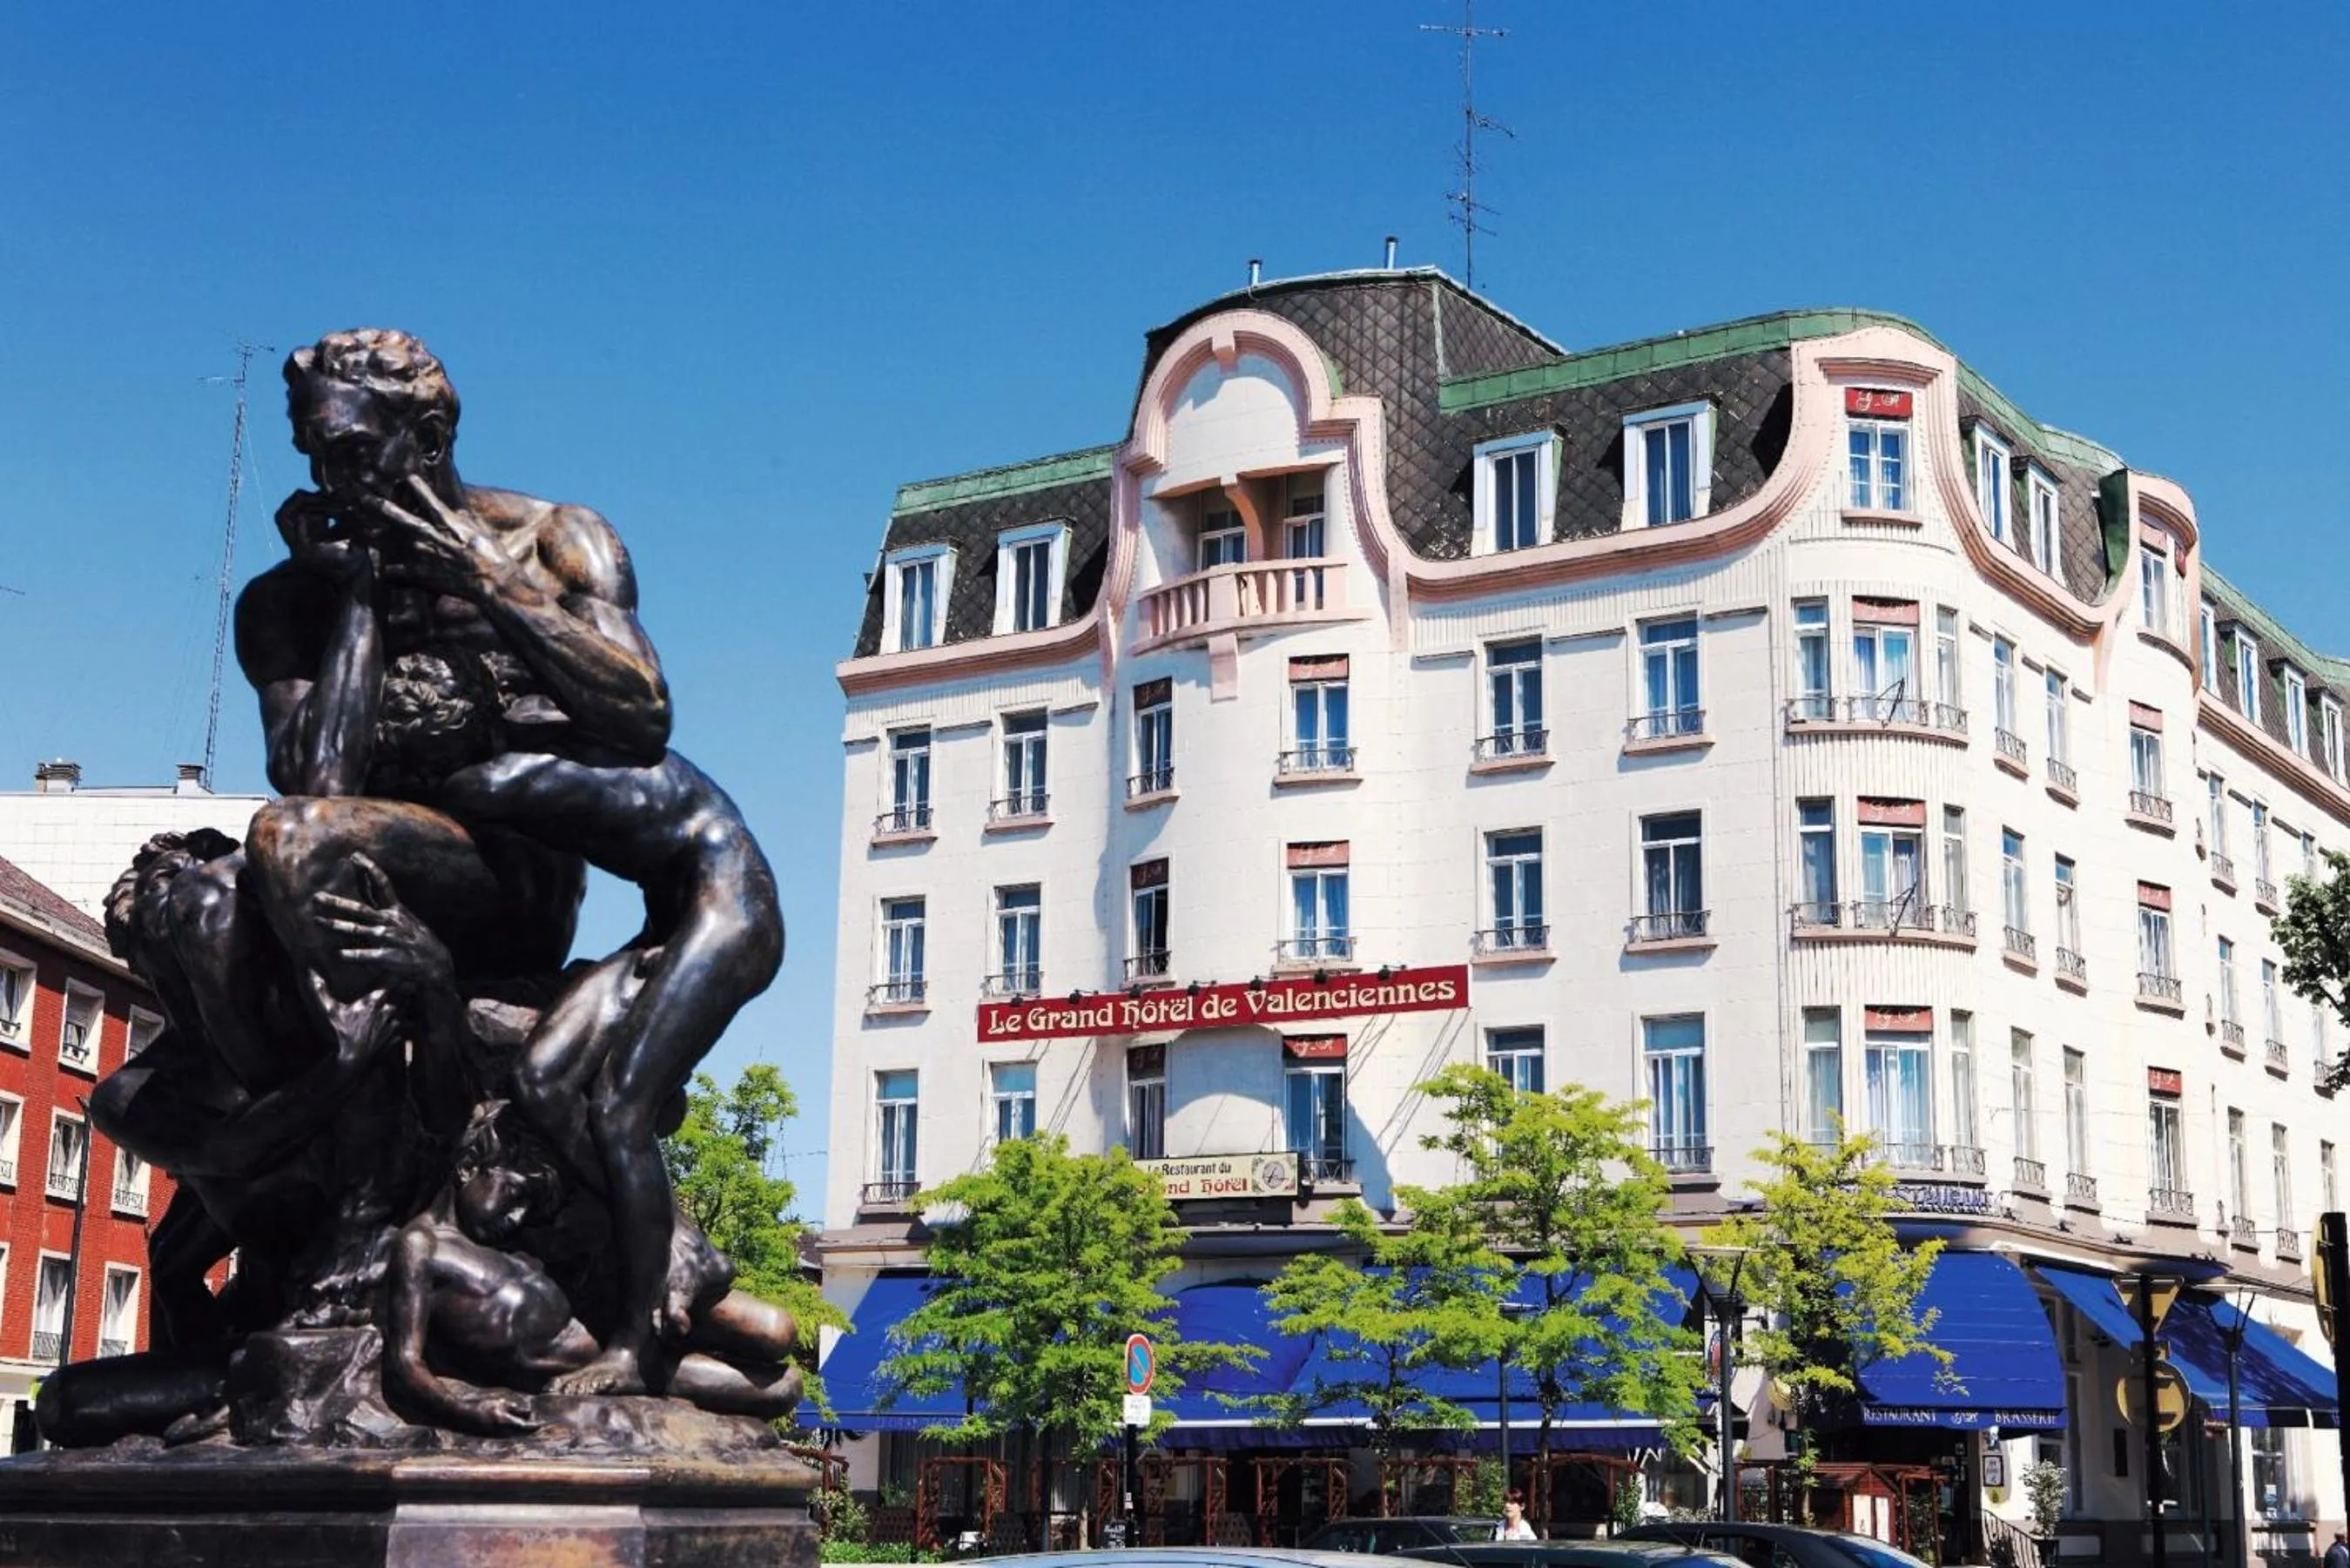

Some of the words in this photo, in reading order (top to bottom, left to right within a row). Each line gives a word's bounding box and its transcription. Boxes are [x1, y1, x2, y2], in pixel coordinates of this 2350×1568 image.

[987, 1009, 1022, 1034] Le
[1027, 1002, 1114, 1032] Grand
[1201, 993, 1238, 1020] de
[1244, 979, 1457, 1014] Valenciennes
[1162, 1161, 1216, 1175] Restaurant
[1219, 1161, 1231, 1174] du
[1863, 1407, 1936, 1423] RESTAURANT
[1995, 1410, 2057, 1425] BRASSERIE
